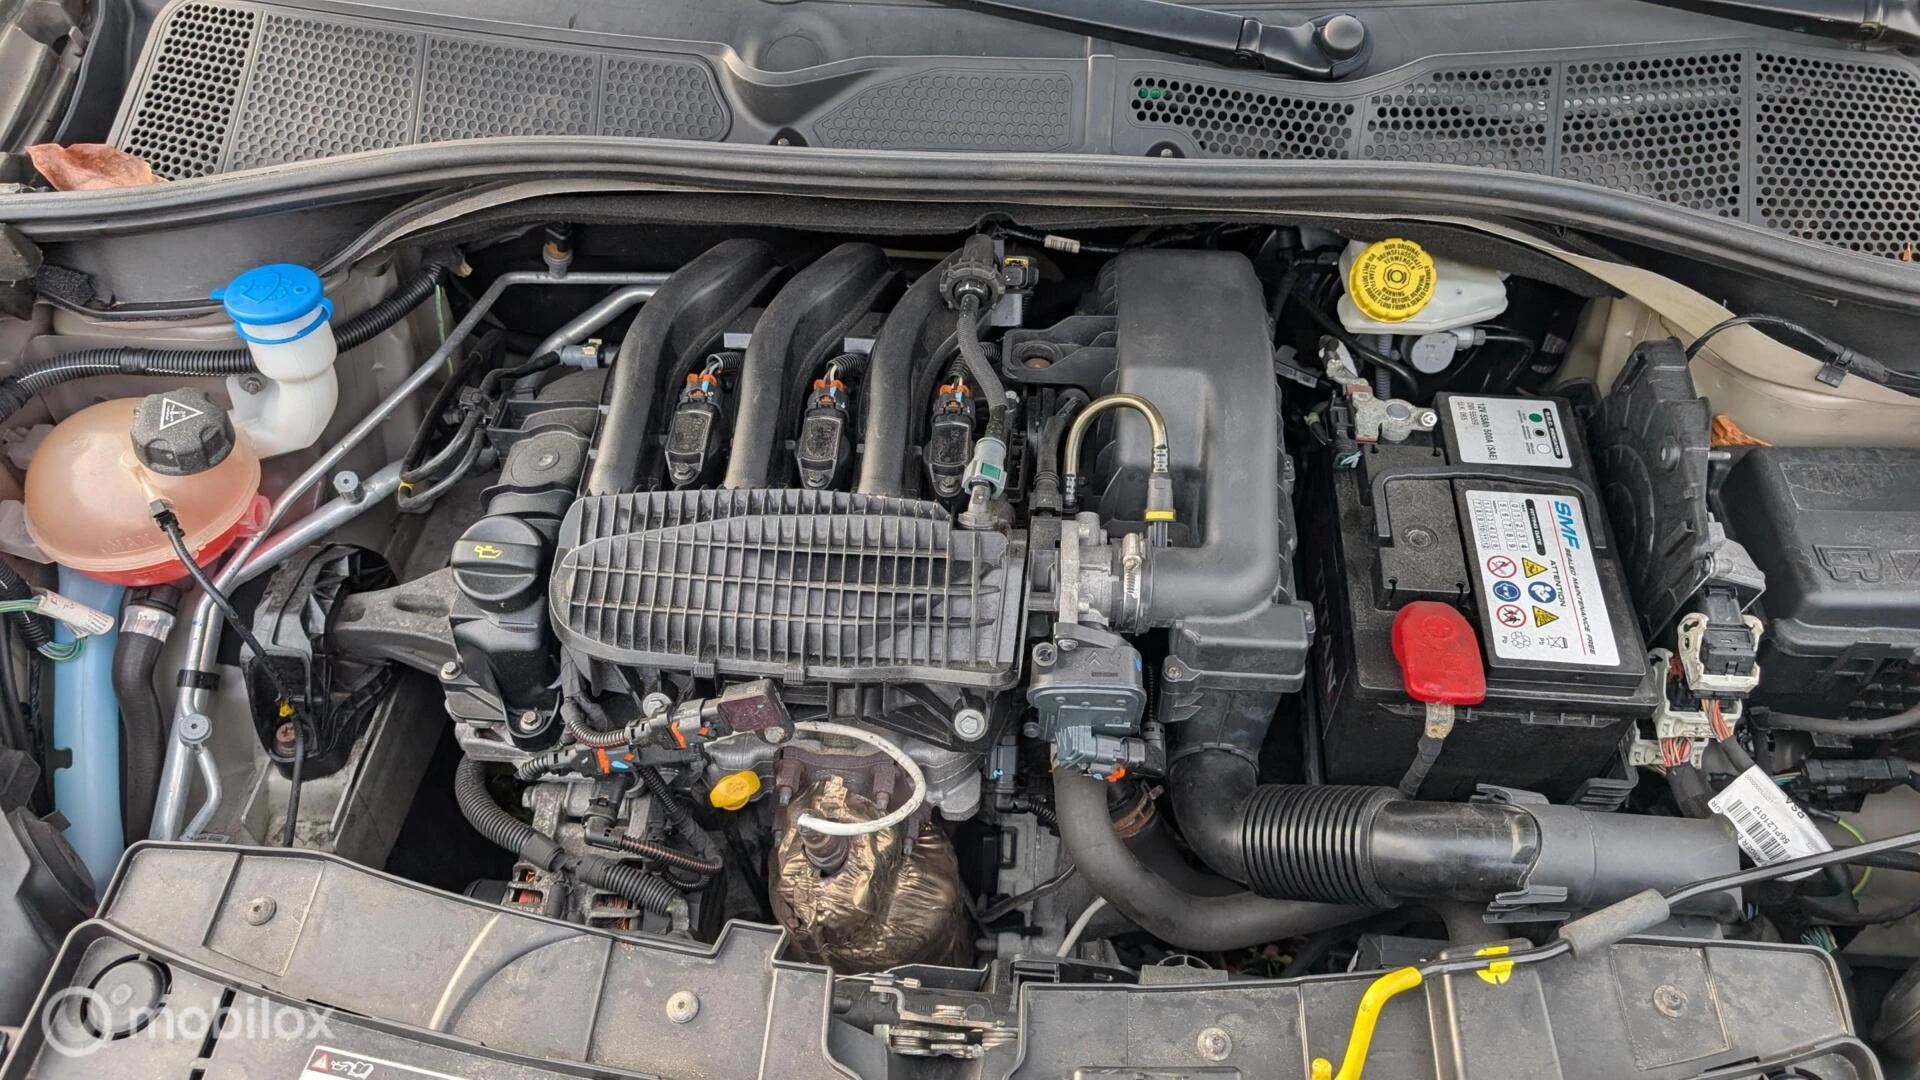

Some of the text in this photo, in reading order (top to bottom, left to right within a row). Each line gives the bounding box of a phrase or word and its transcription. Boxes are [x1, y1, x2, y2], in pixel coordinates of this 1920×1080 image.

[1397, 244, 1420, 257] ORIGINAL
[1365, 288, 1378, 301] BRAKE
[1378, 300, 1391, 309] FLUID
[1410, 293, 1426, 305] SEALED
[1371, 281, 1382, 296] FILLER
[1477, 403, 1497, 460] 12V 55Ah 500A (SAE)
[1529, 508, 1542, 545] FITTING DATE
[1554, 501, 1580, 549] SMF
[1550, 560, 1566, 607] ATTENTION
[1565, 548, 1596, 654] SEALED MAINTENANCE FREE
[1752, 806, 1790, 844] 56PL21013
